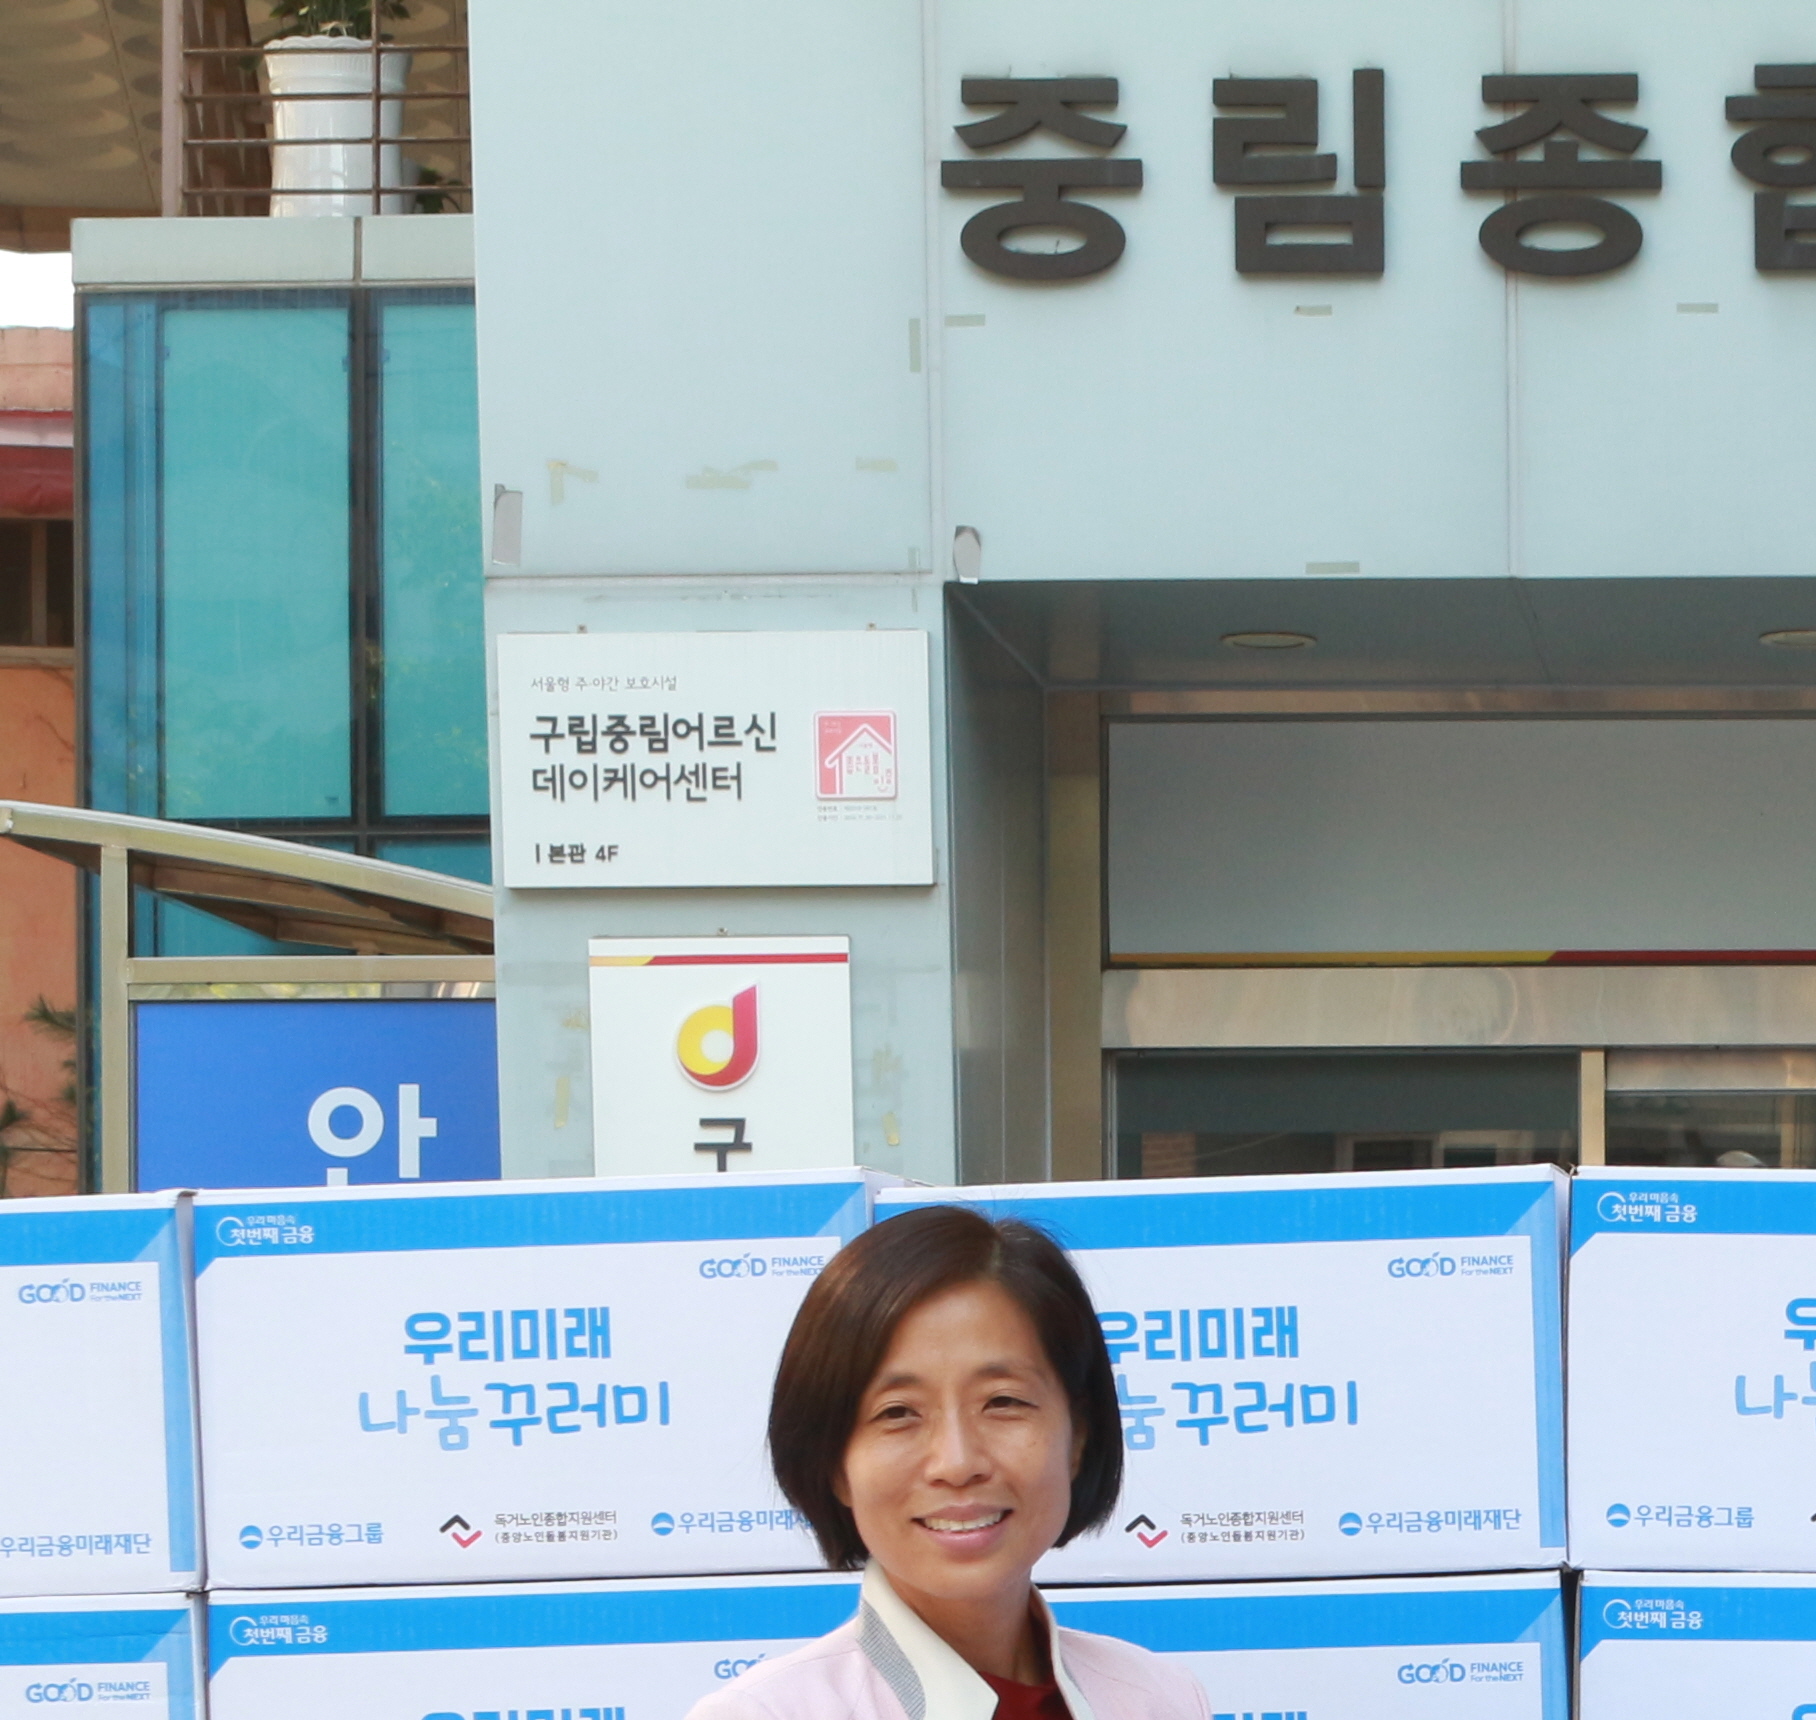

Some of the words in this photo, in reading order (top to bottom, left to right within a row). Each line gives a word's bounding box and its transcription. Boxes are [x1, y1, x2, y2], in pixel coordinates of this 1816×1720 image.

[532, 677, 569, 692] 서울형
[626, 676, 676, 691] 보호시설
[530, 712, 776, 754] 구립중림어르신
[533, 762, 741, 802] 데이케어센터
[548, 843, 586, 864] 본관
[595, 845, 618, 861] 4F
[1612, 1203, 1662, 1222] 첫번째
[1665, 1204, 1697, 1223] 금융
[230, 1227, 279, 1246] 첫번째
[282, 1225, 314, 1245] 금융
[699, 1253, 767, 1279] GOOD
[771, 1255, 824, 1267] FINANCE
[1388, 1252, 1456, 1279] GOOD
[1460, 1254, 1514, 1266] FINANCE
[18, 1279, 85, 1304] GOOD
[90, 1281, 142, 1293] FINANCE
[404, 1306, 612, 1365] 우리미래
[495, 1510, 616, 1527] 독거노인종합지원센터
[1181, 1510, 1304, 1527] 독거노인종합지원센터
[1366, 1509, 1522, 1534] 우리금융미래재단
[1634, 1505, 1754, 1529] 우리금융그룹
[267, 1522, 384, 1546] 우리금융그룹
[1617, 1610, 1667, 1629] 첫번째
[1670, 1611, 1703, 1630] 금융
[244, 1626, 293, 1646] 첫번째
[296, 1624, 328, 1644] 금융
[1398, 1659, 1466, 1685] GOOD
[1470, 1661, 1524, 1673] FINANCE
[26, 1678, 93, 1704] GOOD
[97, 1680, 150, 1692] FINANCE
